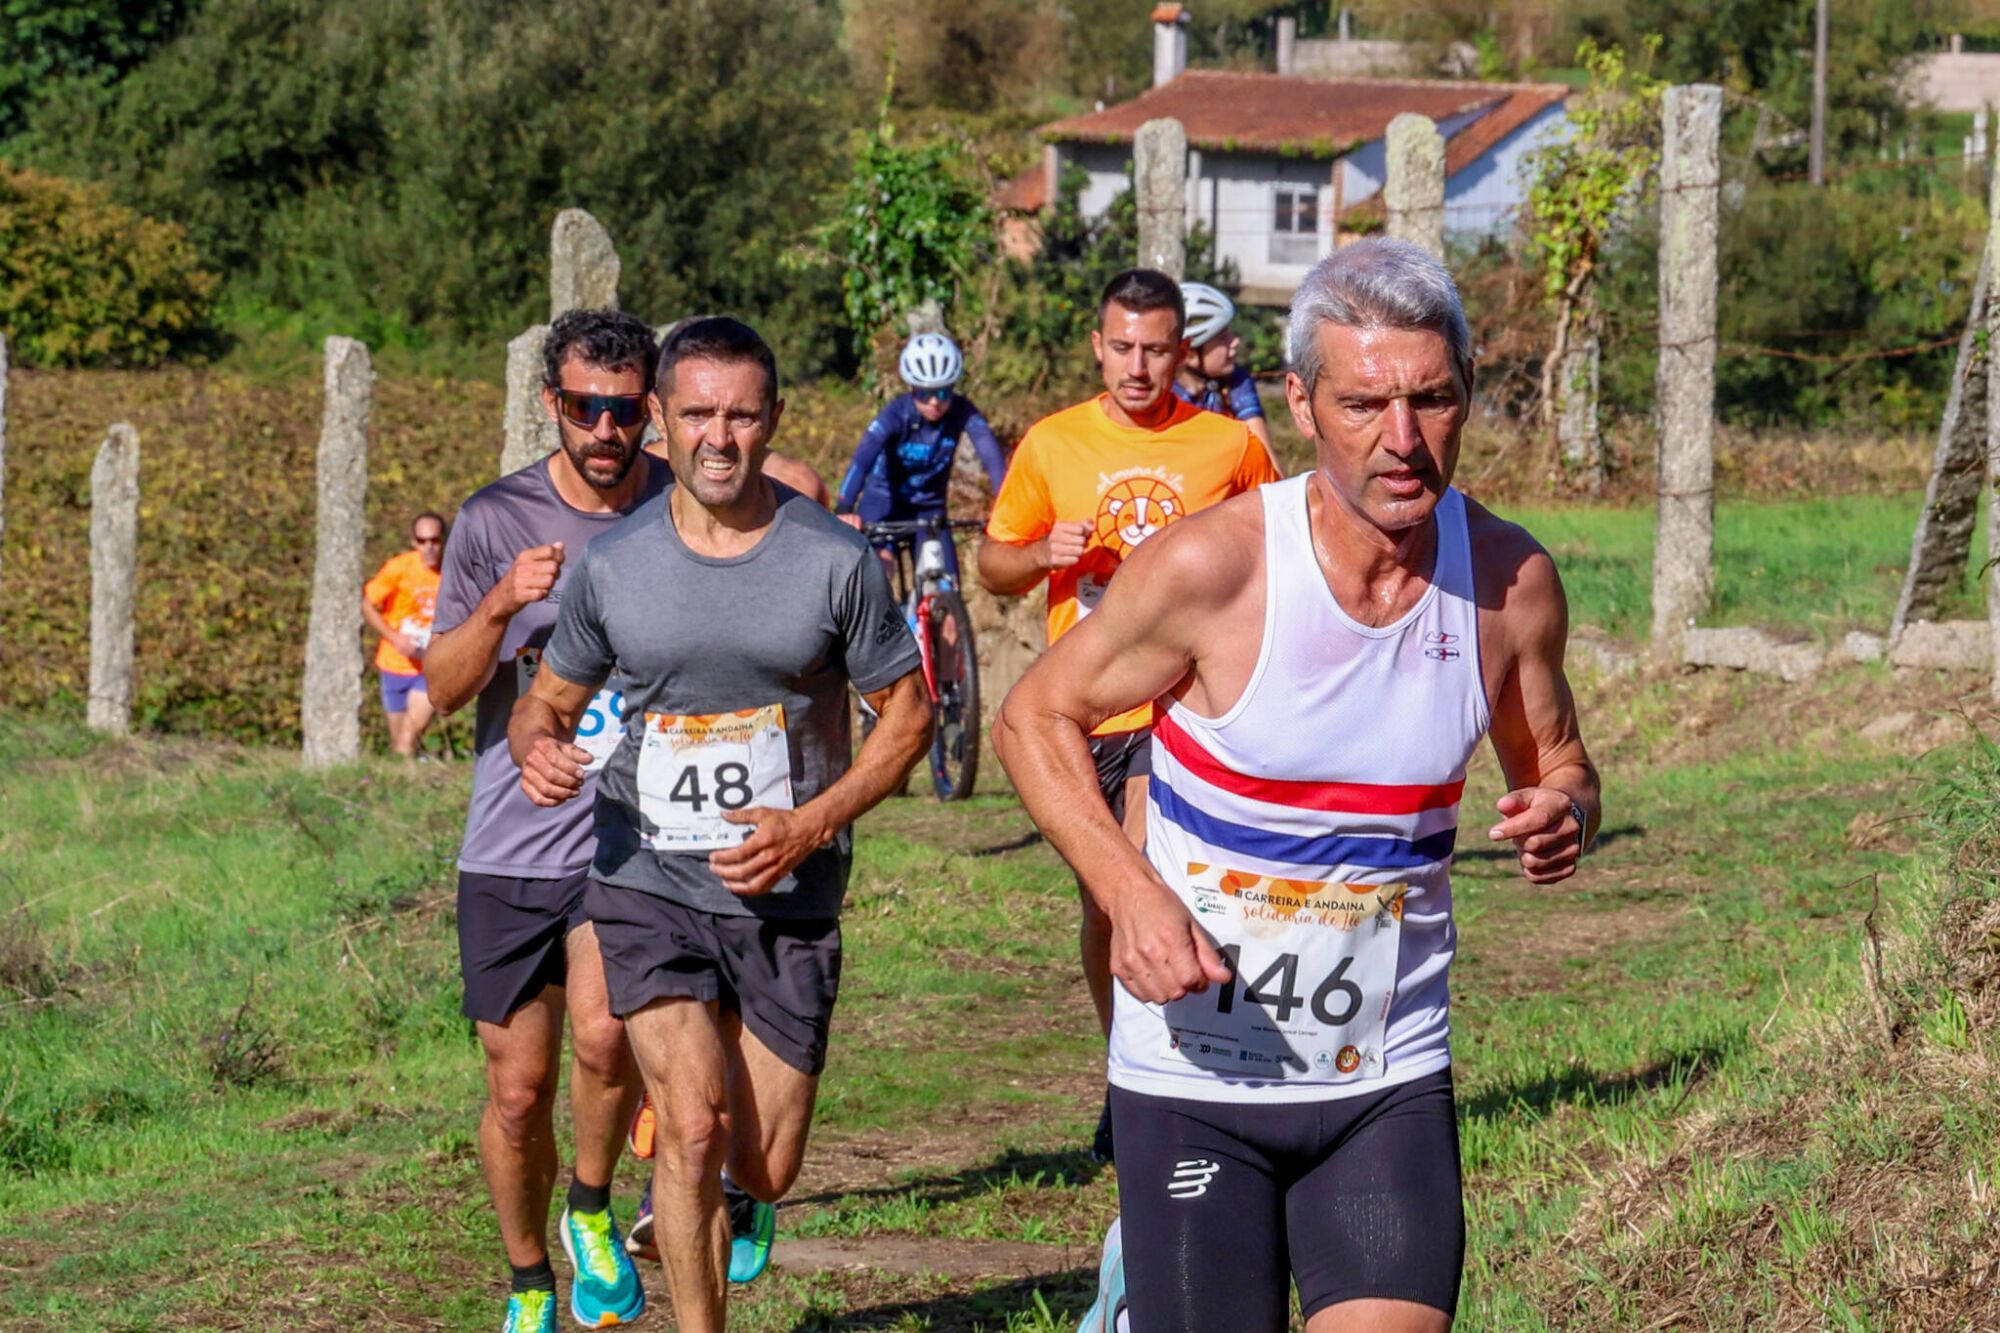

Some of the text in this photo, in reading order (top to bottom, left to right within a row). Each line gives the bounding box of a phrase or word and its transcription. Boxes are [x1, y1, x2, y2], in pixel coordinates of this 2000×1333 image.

[669, 762, 753, 812] 48
[1244, 891, 1301, 908] CARREIRA
[1304, 898, 1311, 908] E
[1313, 900, 1366, 912] ANDAINA
[1318, 911, 1337, 927] de
[1216, 943, 1363, 1027] 146
